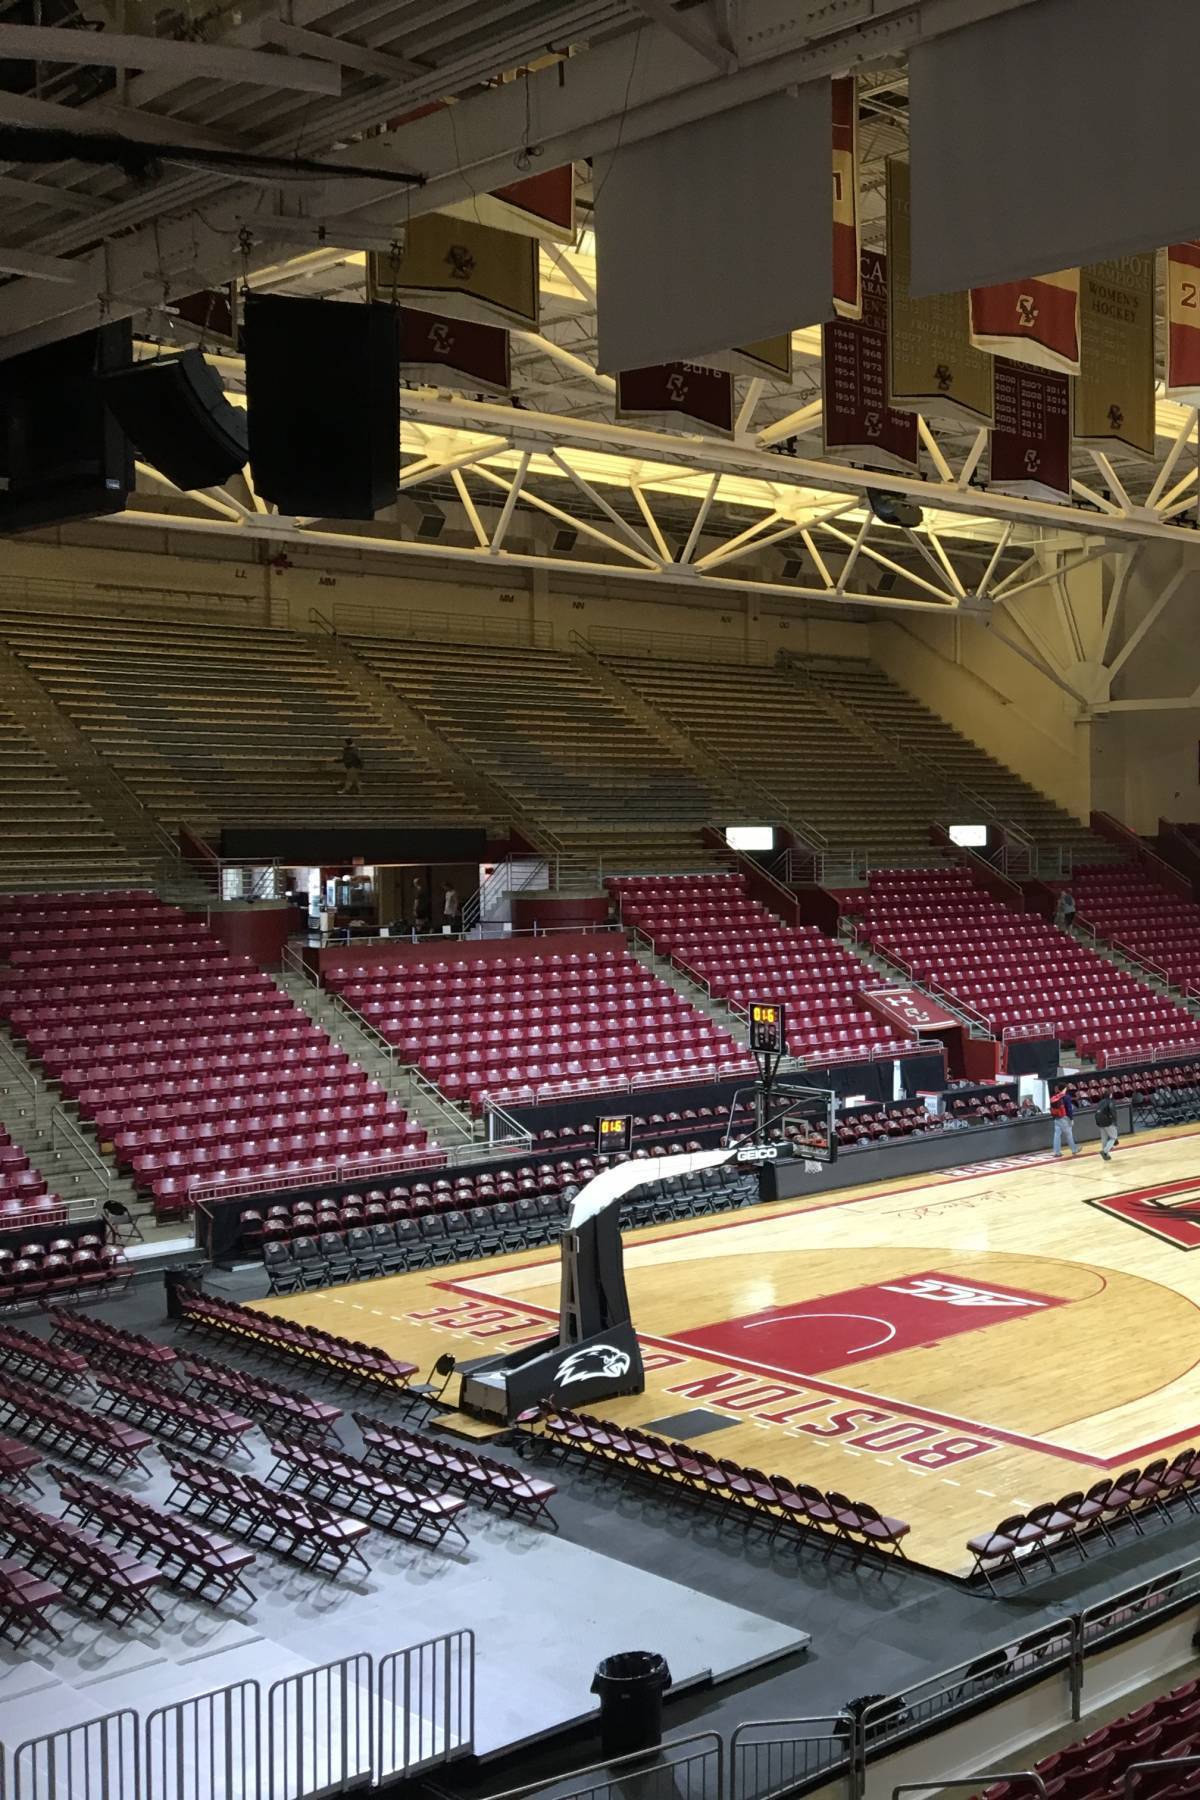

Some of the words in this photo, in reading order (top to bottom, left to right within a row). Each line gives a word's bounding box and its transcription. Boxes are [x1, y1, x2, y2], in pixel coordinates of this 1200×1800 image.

[1088, 281, 1138, 309] WOMEN'S
[1091, 300, 1136, 324] HOCKEY
[736, 1148, 778, 1162] GEICO
[880, 1278, 1047, 1307] ACC
[662, 1371, 1003, 1471] BOSTON
